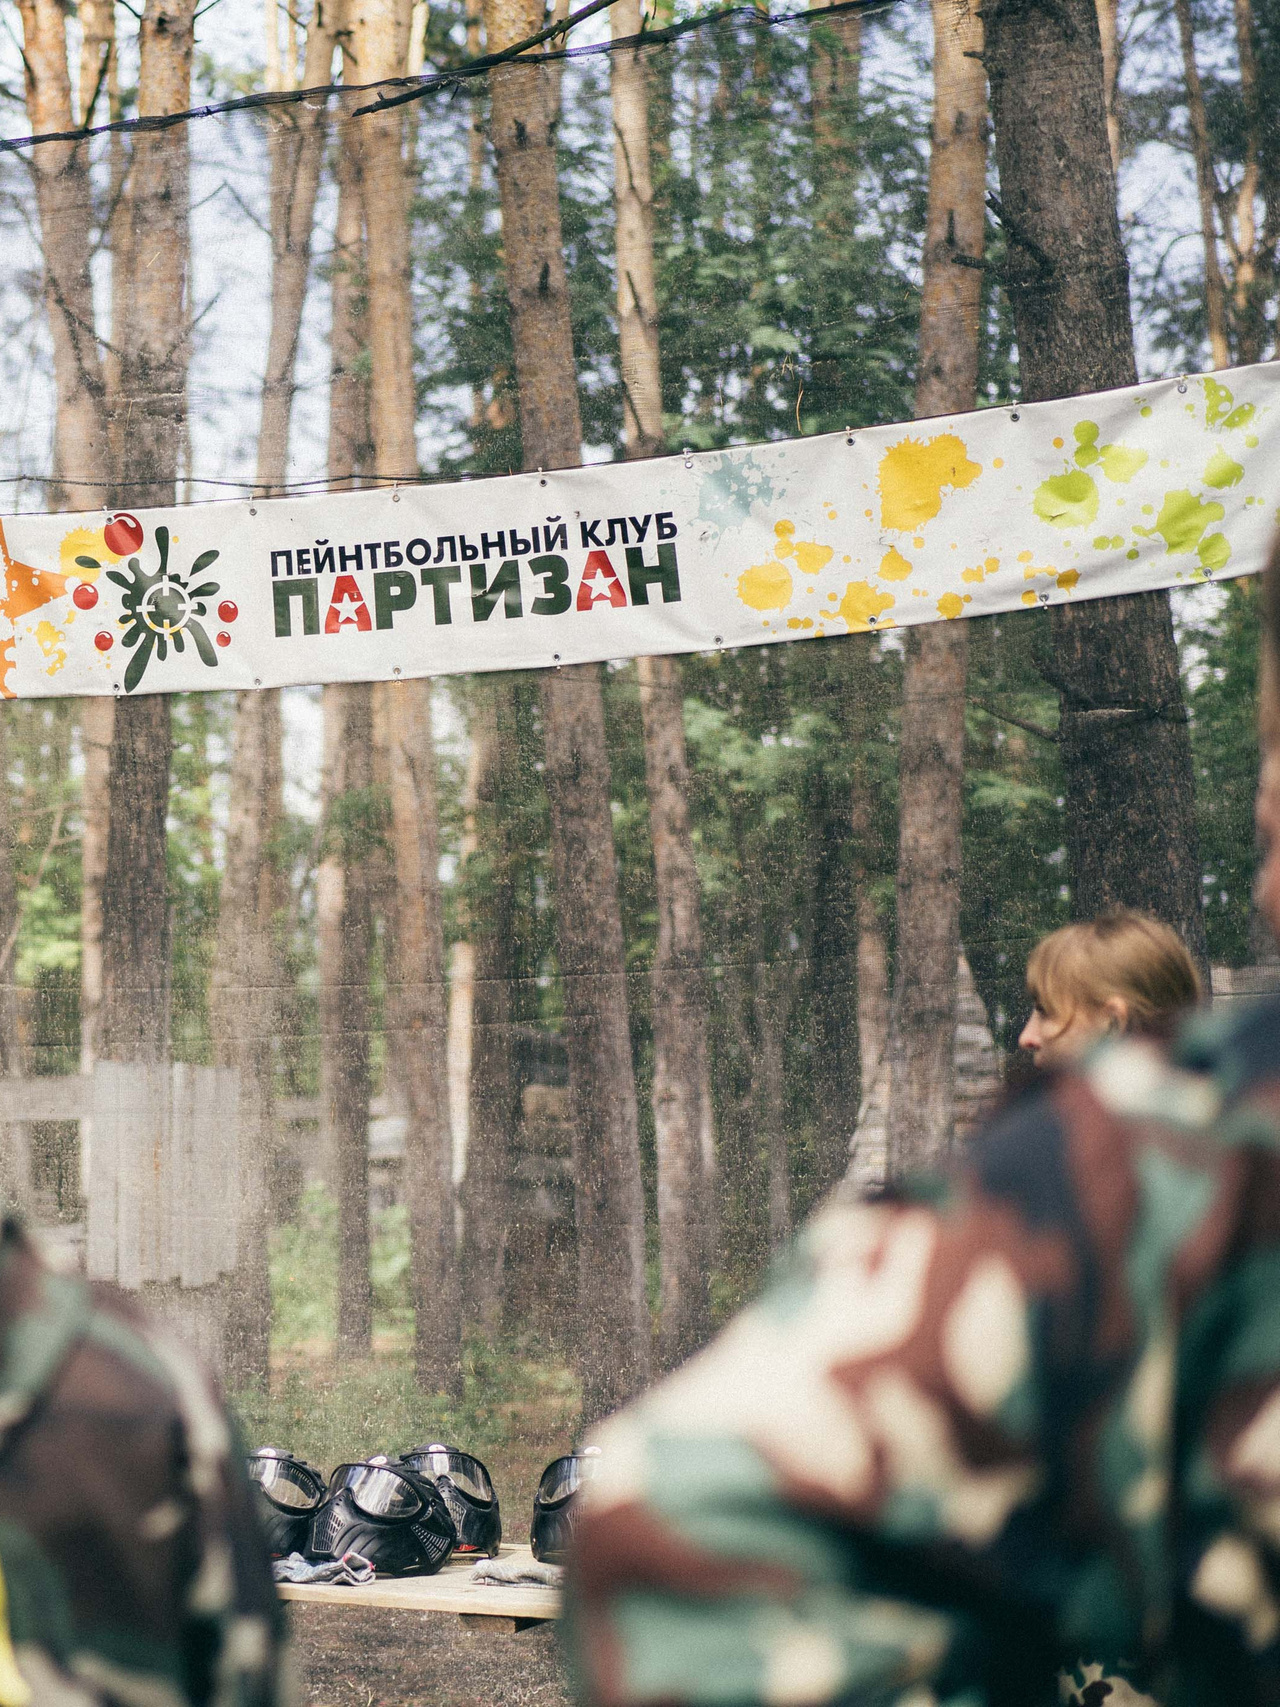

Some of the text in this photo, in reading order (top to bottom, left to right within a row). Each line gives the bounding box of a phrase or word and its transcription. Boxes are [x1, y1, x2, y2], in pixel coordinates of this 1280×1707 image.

[271, 511, 678, 577] ПЕЙНТБОЛЬНЫЙ КЛУБ
[272, 542, 682, 638] ПАРТИЗАН
